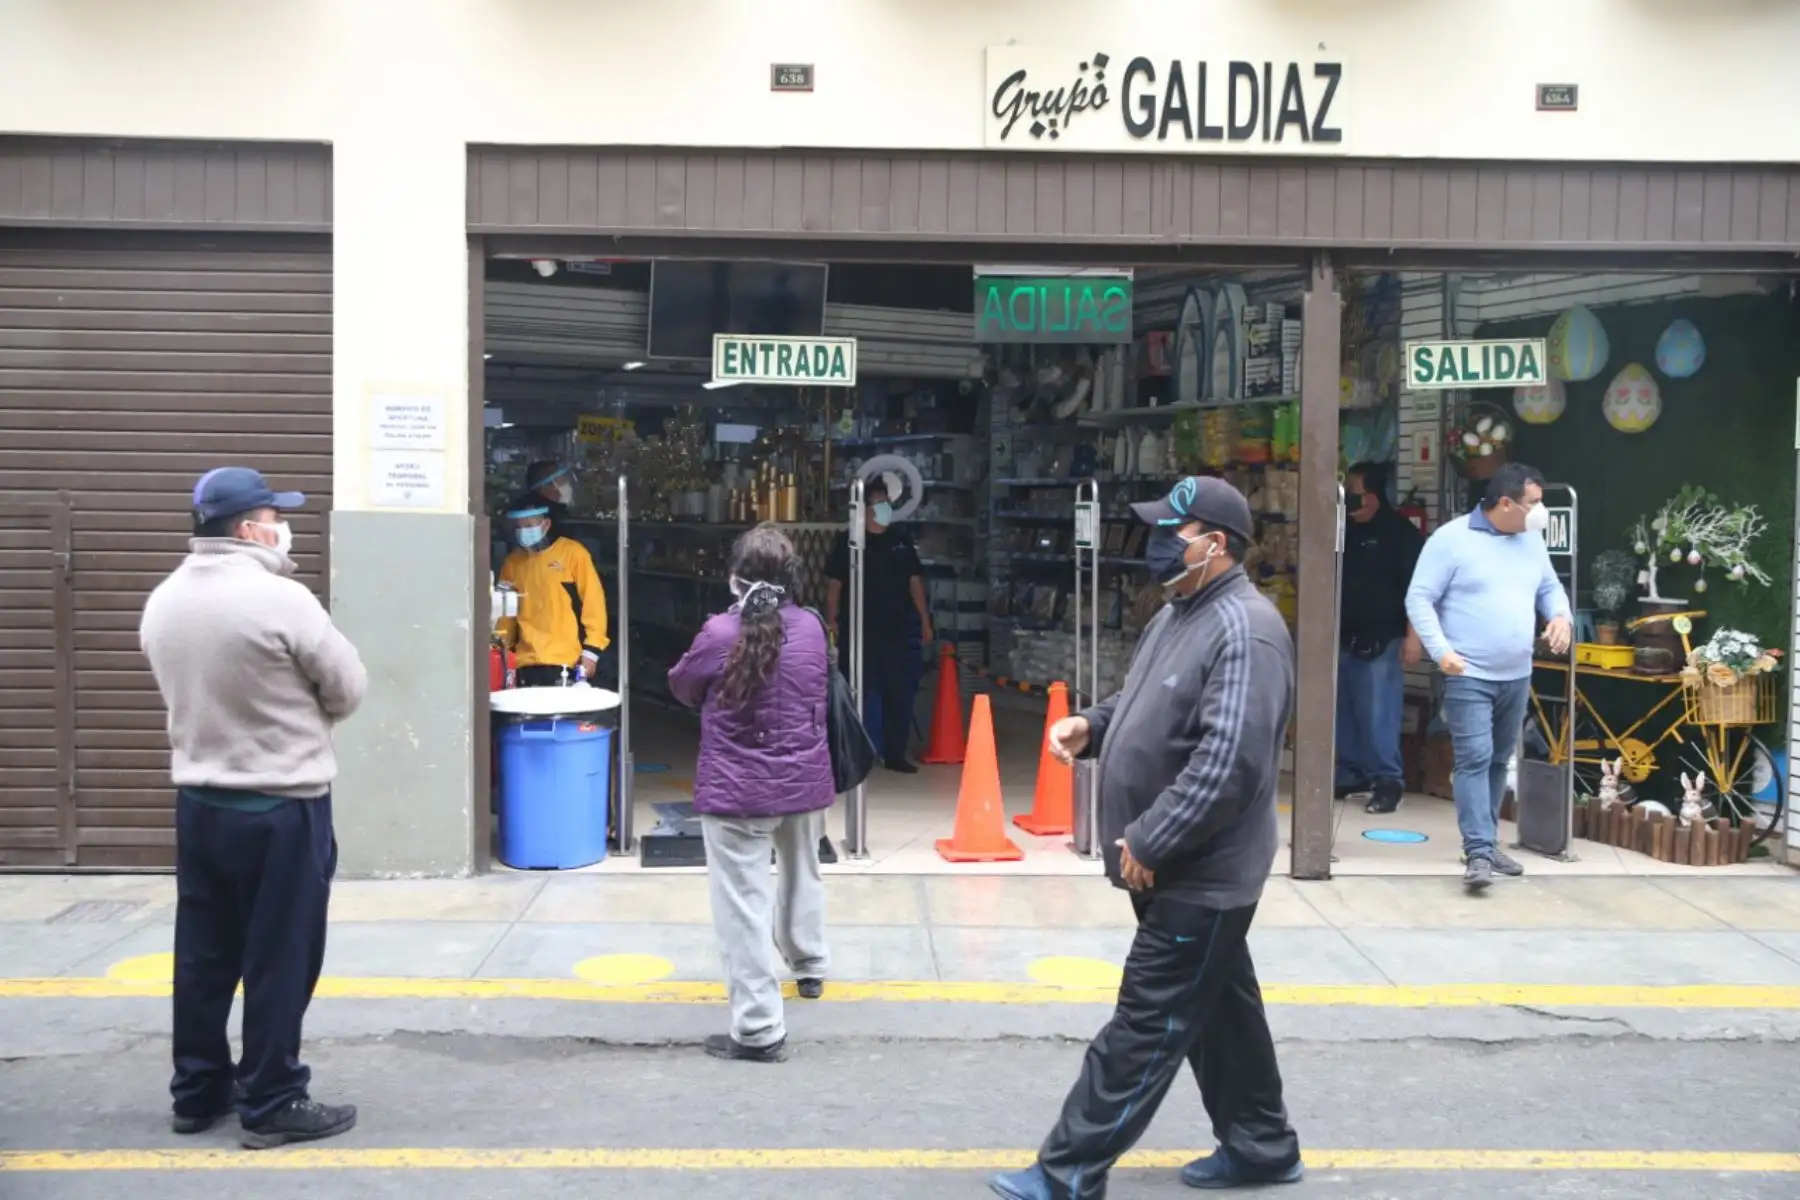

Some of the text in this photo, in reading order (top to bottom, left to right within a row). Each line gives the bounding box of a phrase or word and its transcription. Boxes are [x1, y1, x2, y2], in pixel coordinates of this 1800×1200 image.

[781, 73, 804, 84] 638
[993, 56, 1342, 142] Grupo GALDIAZ
[724, 342, 846, 377] ENTRADA
[1414, 344, 1539, 382] SALIDA
